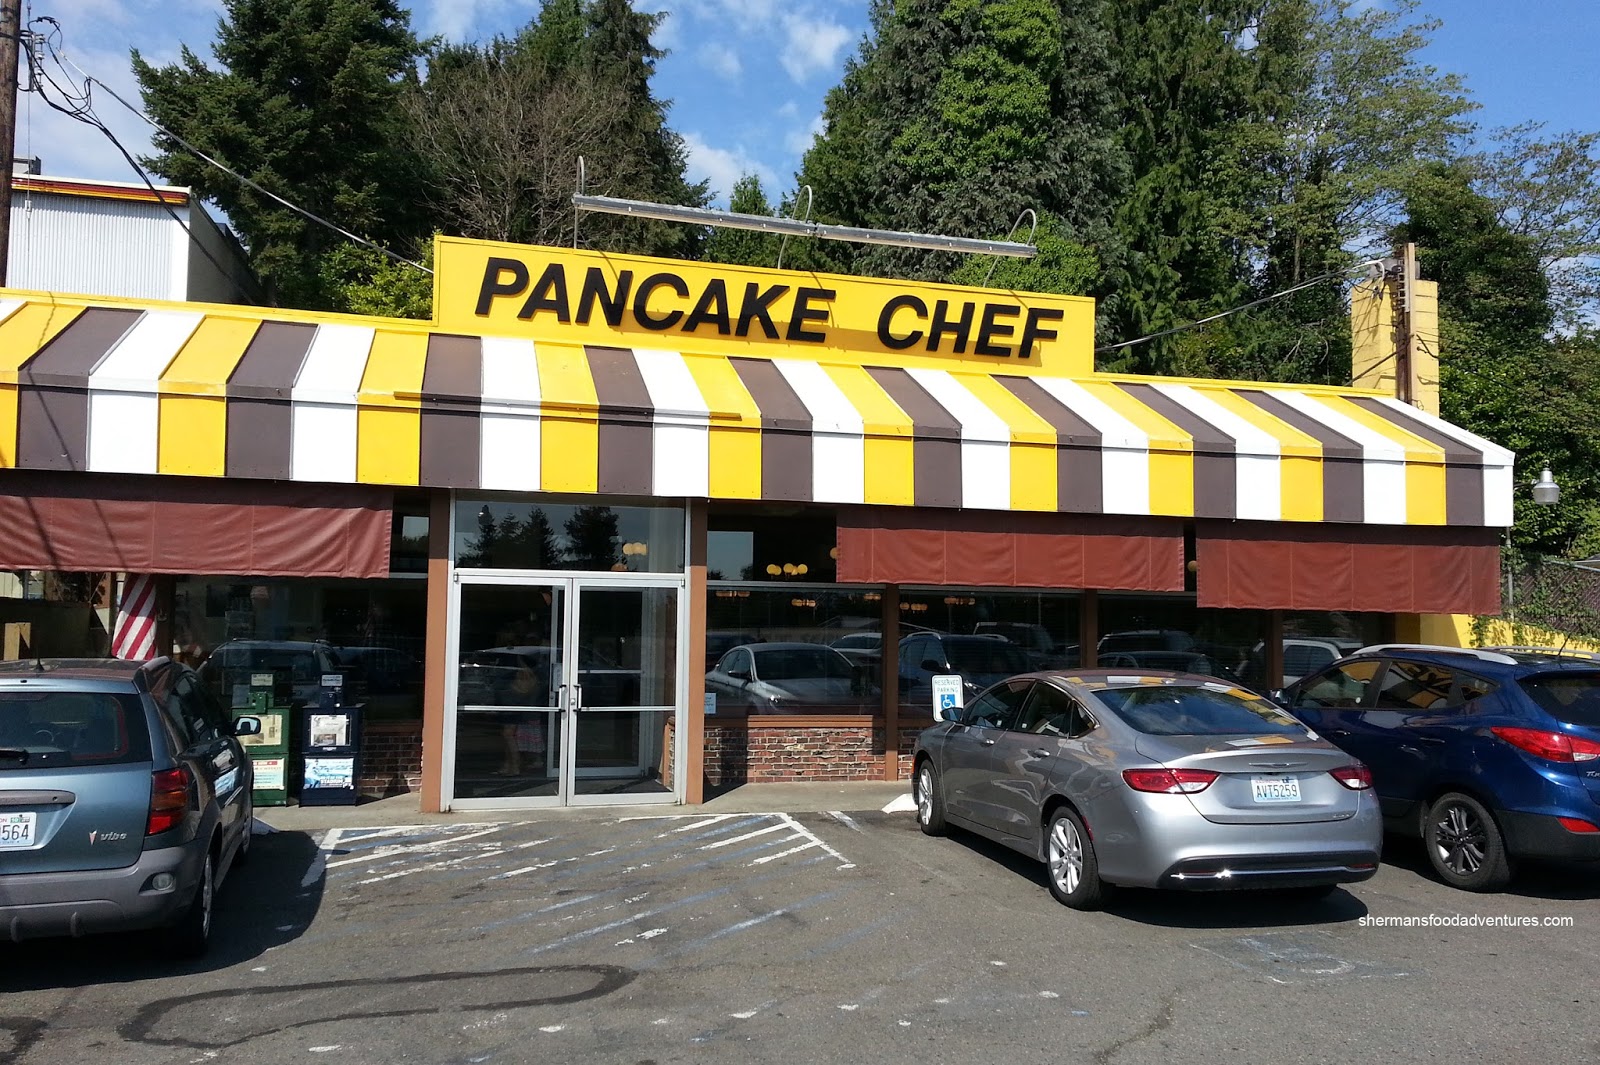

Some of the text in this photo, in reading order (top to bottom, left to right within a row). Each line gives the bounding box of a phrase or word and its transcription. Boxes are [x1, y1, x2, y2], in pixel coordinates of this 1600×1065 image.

[475, 257, 1064, 358] PANCAKE CHEF
[1256, 784, 1298, 798] AVT5259
[0, 824, 29, 841] 564
[101, 832, 127, 840] vibe
